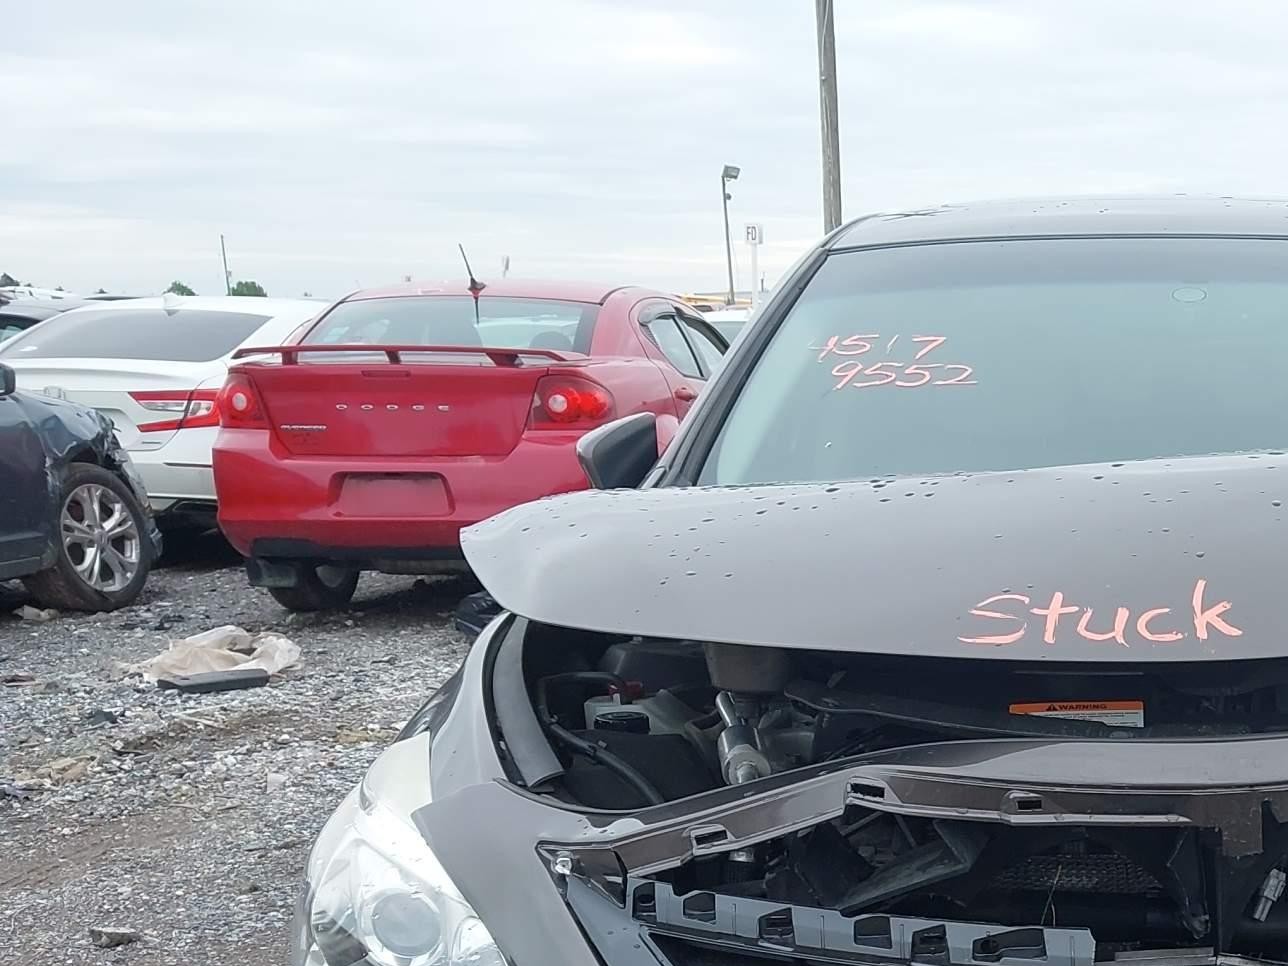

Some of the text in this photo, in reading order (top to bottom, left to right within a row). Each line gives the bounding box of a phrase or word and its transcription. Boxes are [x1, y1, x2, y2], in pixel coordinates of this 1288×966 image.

[808, 334, 947, 363] 4517
[832, 360, 979, 391] 9552
[957, 579, 1243, 648] Stuck
[1059, 703, 1108, 711] WARNING
